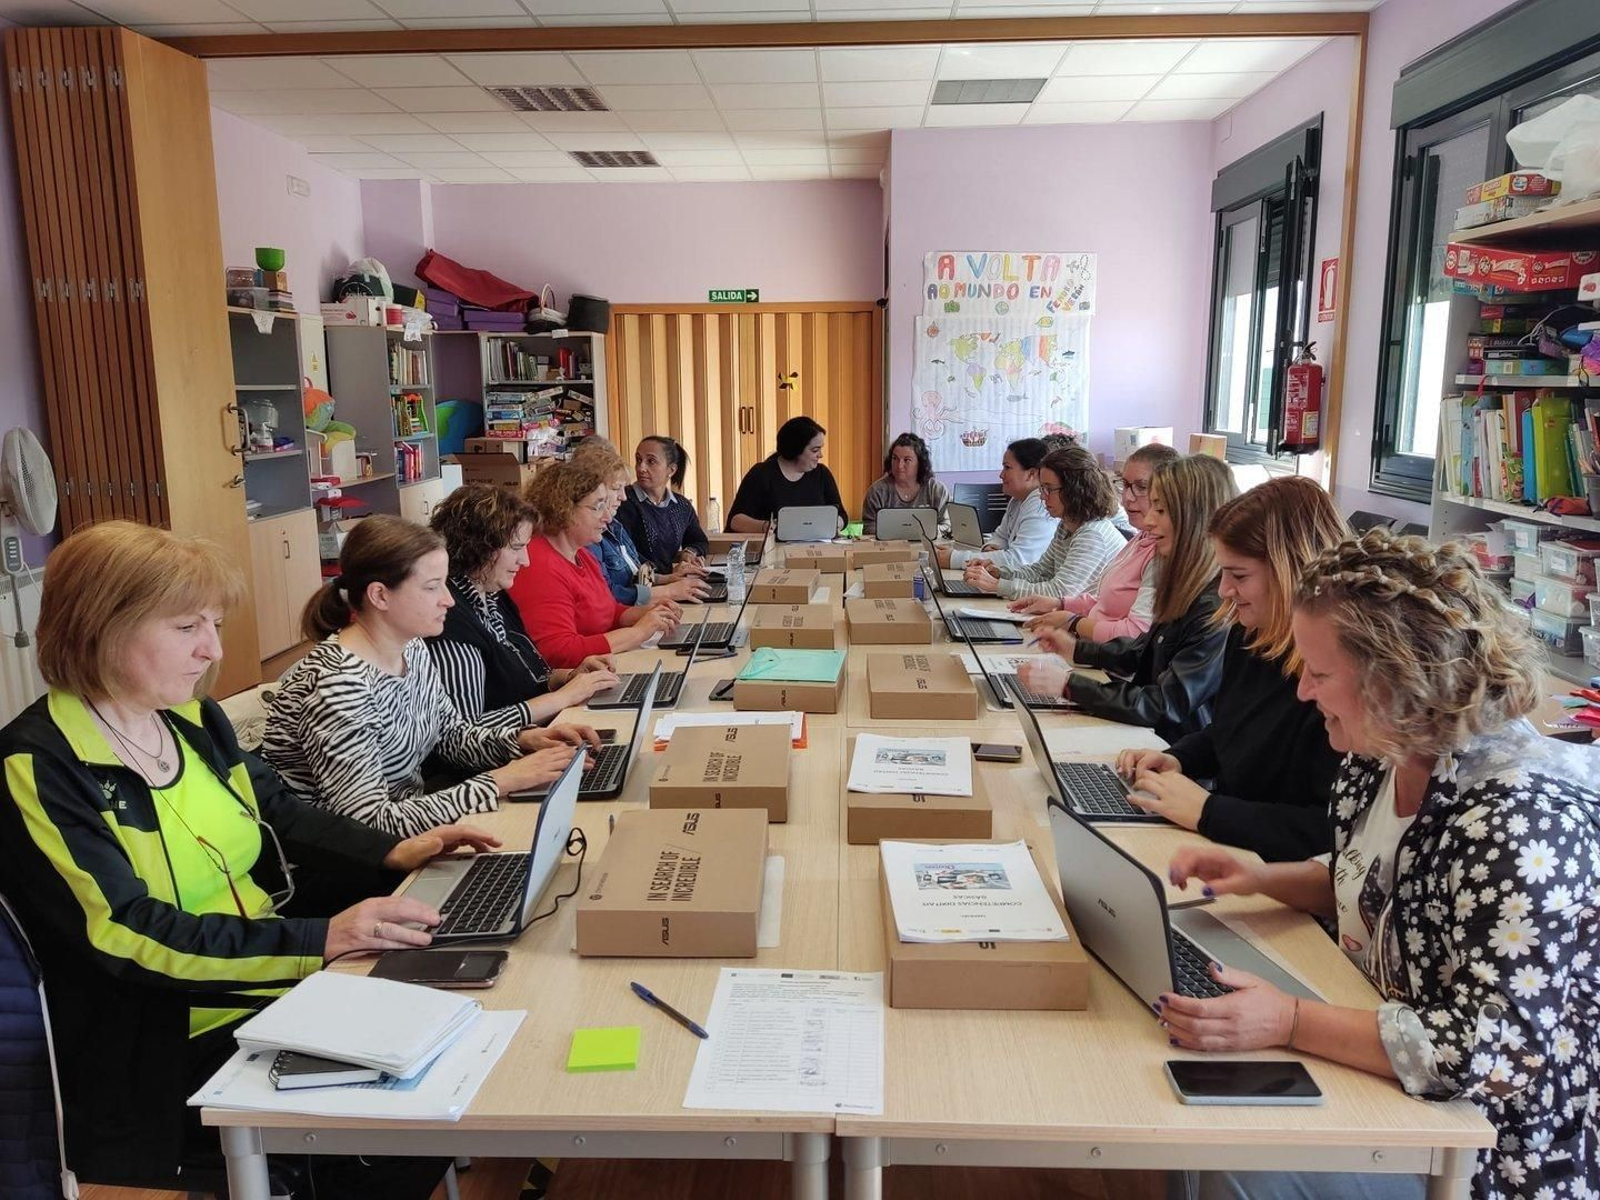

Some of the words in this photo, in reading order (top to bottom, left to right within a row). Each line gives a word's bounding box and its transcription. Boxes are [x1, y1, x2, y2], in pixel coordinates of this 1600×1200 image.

[937, 254, 956, 281] A
[966, 253, 1062, 282] VOLTA
[711, 291, 743, 300] SALIDA
[927, 283, 950, 300] AO
[954, 282, 1020, 301] MUNDO
[1029, 285, 1053, 299] EN
[682, 811, 701, 836] ASUS
[660, 850, 681, 860] OF
[649, 861, 678, 891] SEARCH
[670, 856, 701, 902] INCREDIBLE
[646, 892, 669, 901] IN
[661, 917, 670, 946] ASUS
